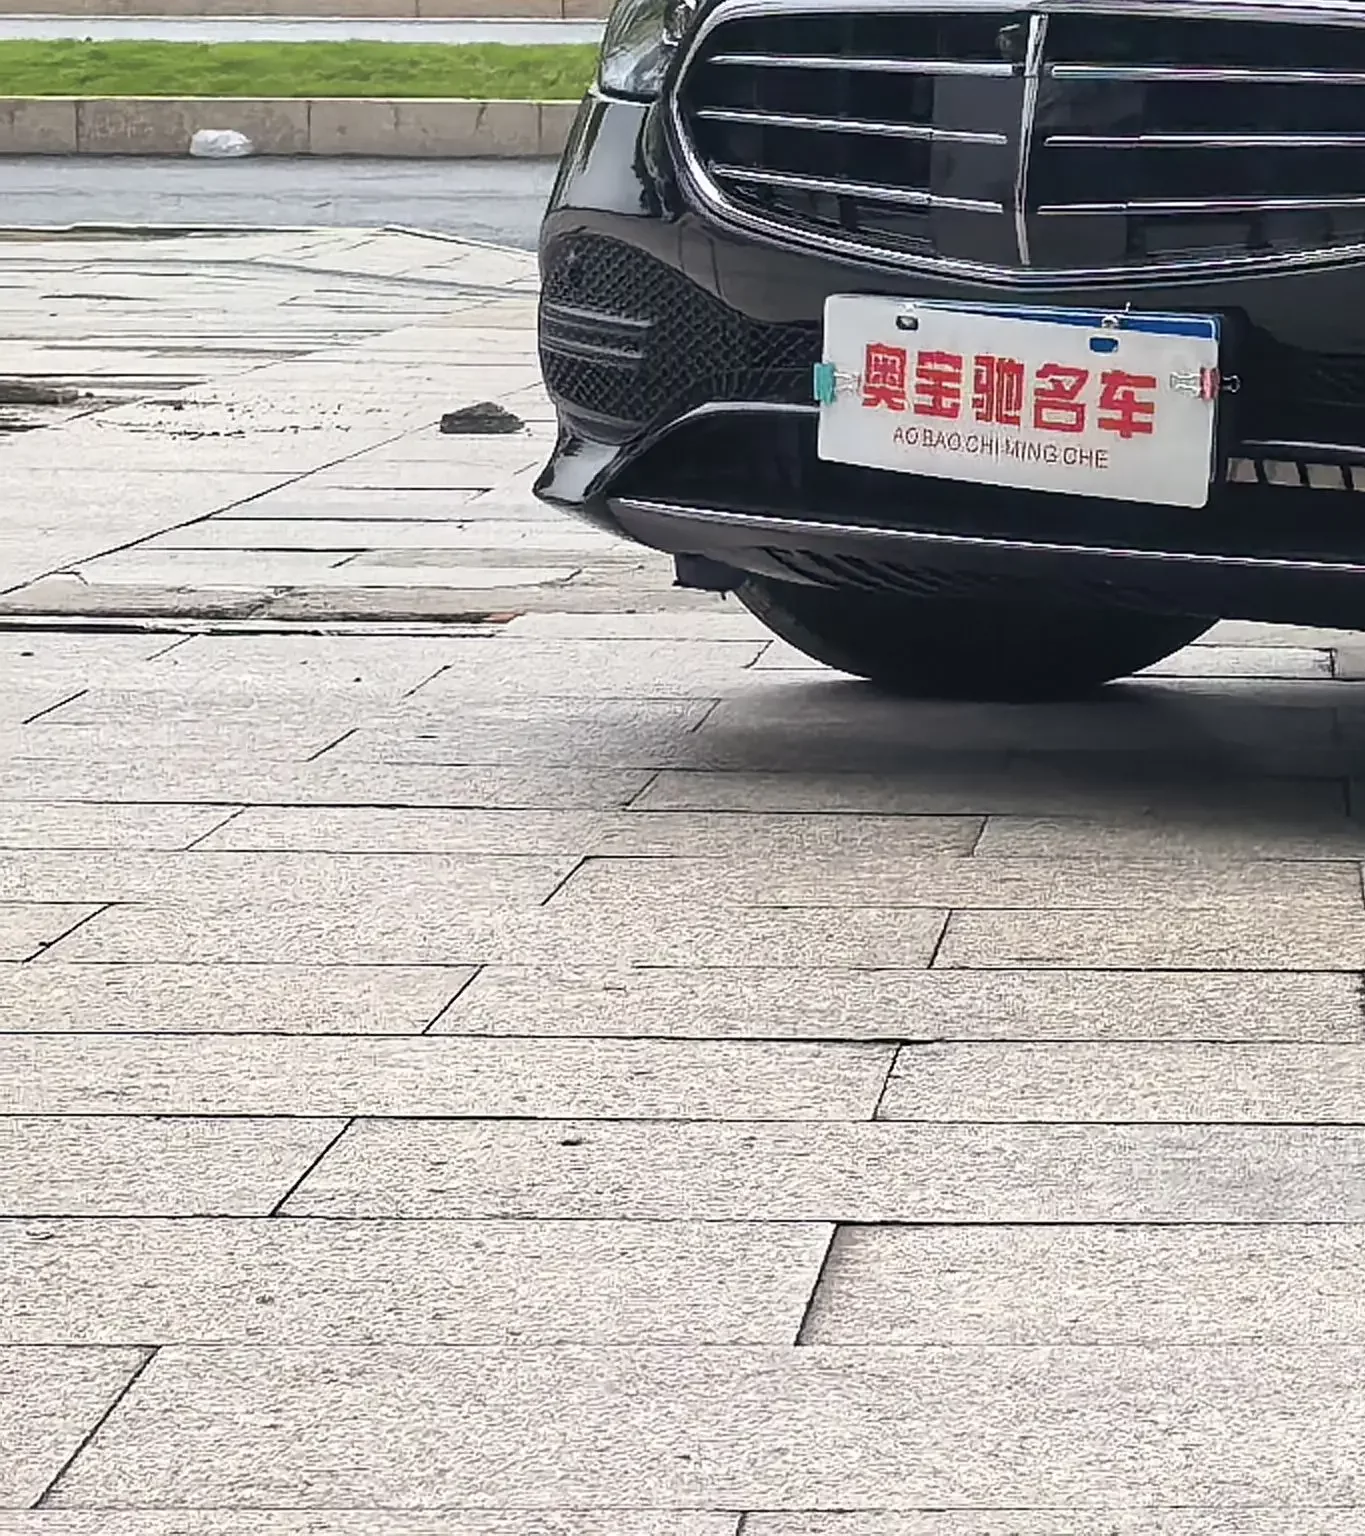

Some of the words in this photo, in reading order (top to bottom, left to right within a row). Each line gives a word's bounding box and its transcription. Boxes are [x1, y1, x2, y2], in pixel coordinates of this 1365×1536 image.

[861, 343, 1157, 439] 奥宝驰名车
